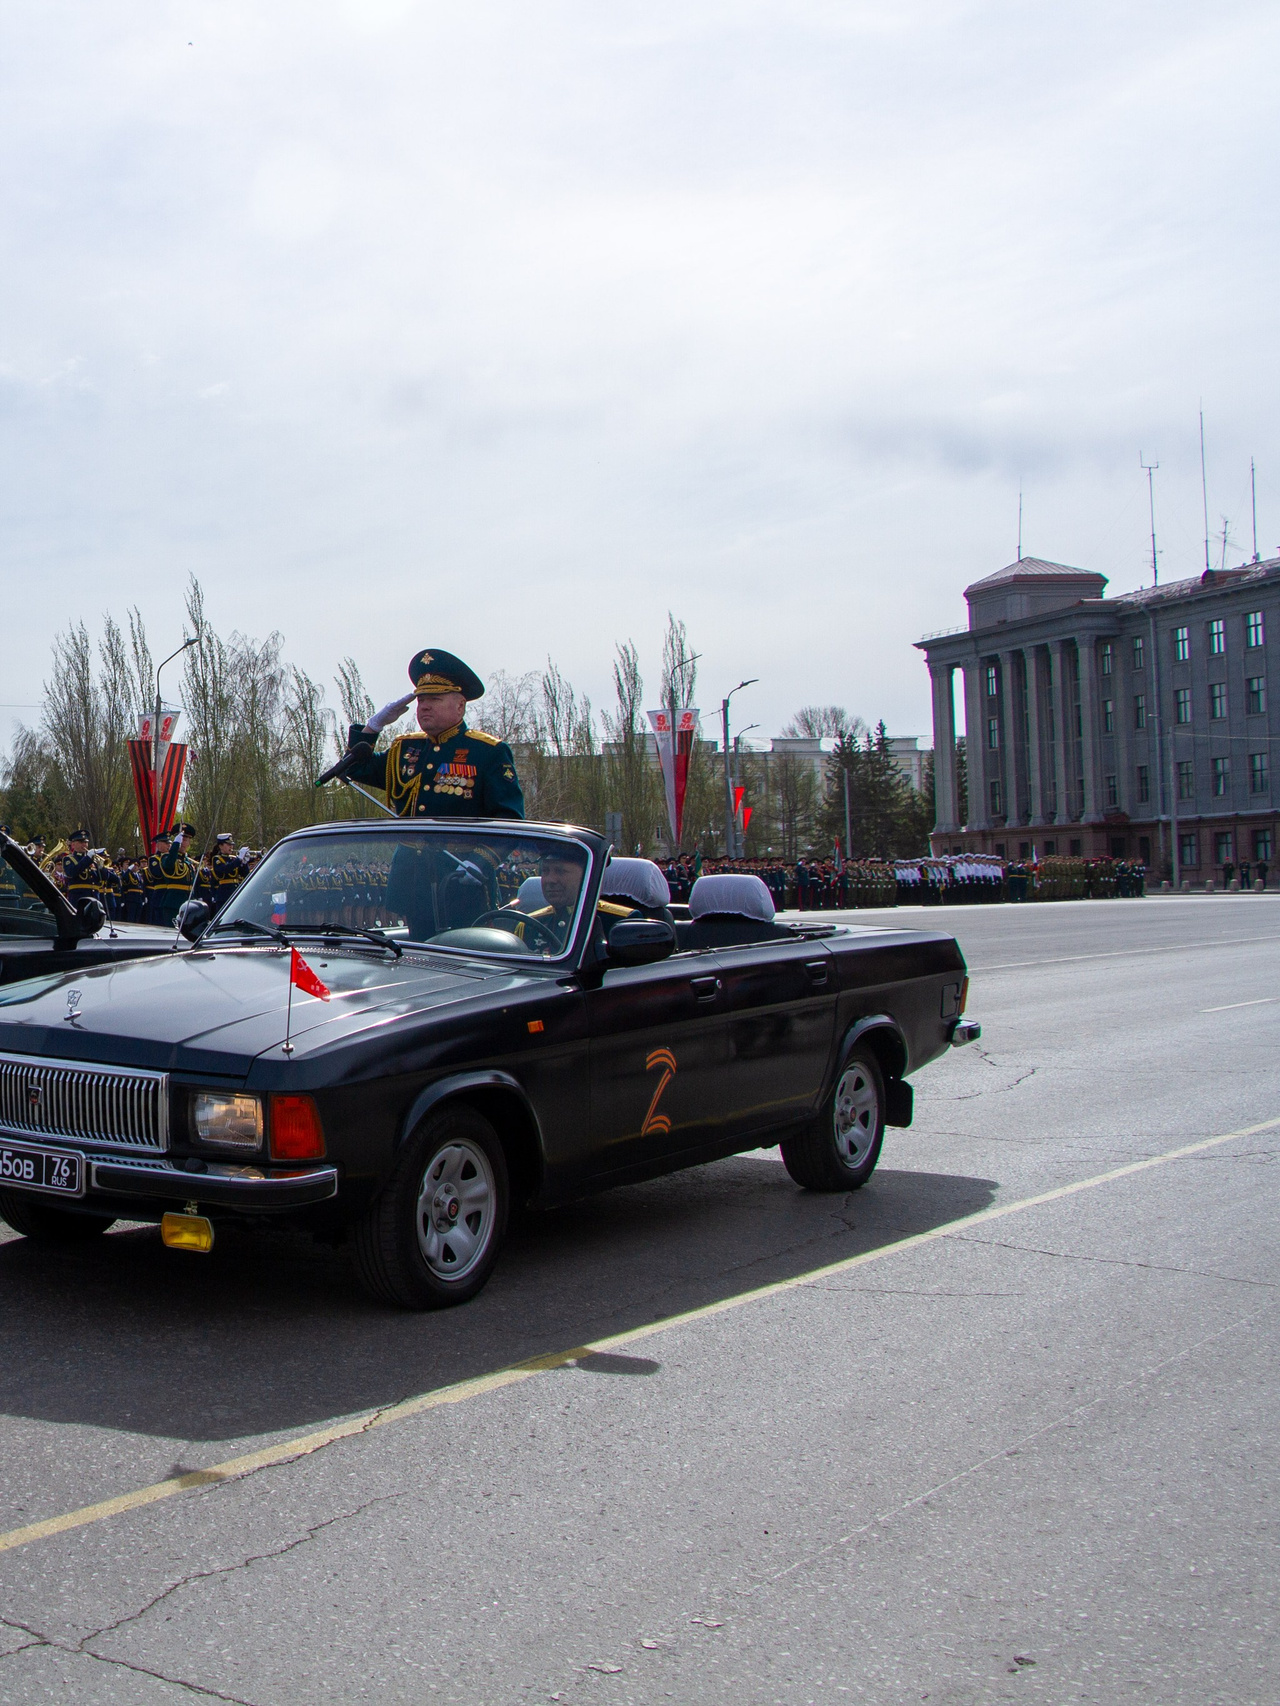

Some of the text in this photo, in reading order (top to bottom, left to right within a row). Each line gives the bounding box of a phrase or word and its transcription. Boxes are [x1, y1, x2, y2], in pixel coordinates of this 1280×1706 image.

[657, 714, 666, 725] 9
[682, 712, 693, 724] 9
[51, 1157, 70, 1177] 76
[51, 1175, 67, 1187] RUS
